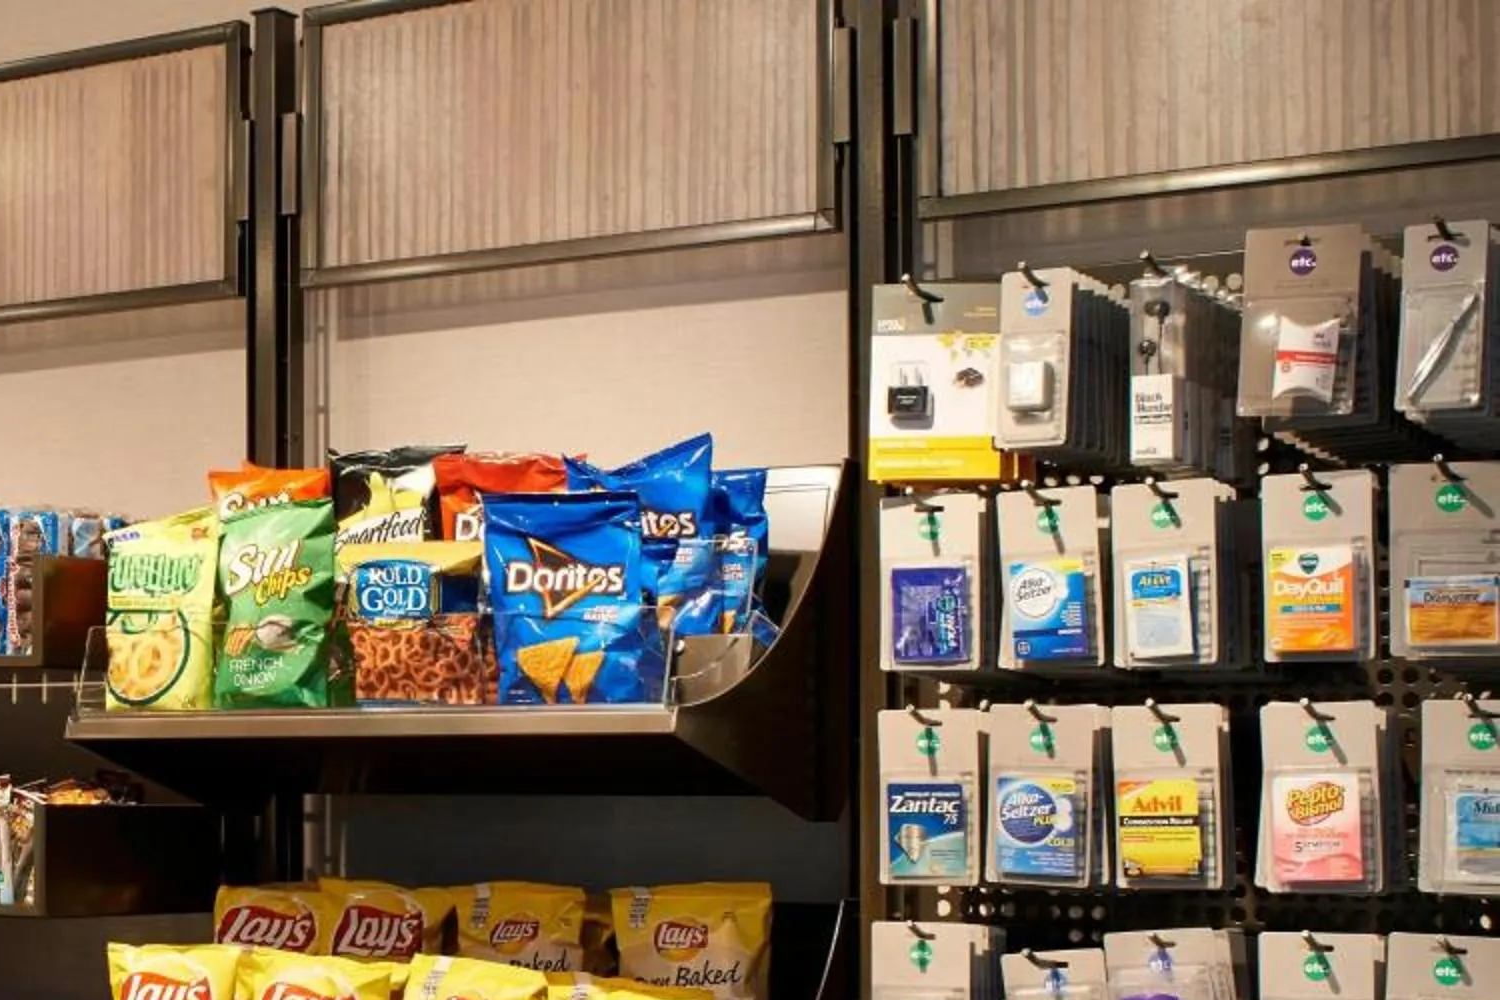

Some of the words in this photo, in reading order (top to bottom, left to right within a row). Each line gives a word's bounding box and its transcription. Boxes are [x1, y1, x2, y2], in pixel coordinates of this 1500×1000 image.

[640, 510, 696, 537] itos
[225, 538, 303, 596] Sun
[367, 564, 423, 587] ROLD
[506, 560, 624, 593] Doritos
[255, 566, 312, 607] Chips
[361, 585, 427, 612] GOLD
[1273, 577, 1345, 599] DayQuil
[229, 656, 284, 672] FRENCH
[232, 671, 278, 687] ONION
[889, 794, 961, 814] Zantac
[1000, 803, 1053, 821] Seltzer
[1131, 795, 1183, 813] Advil
[942, 814, 959, 826] 75
[222, 907, 313, 949] Lay's
[337, 907, 420, 957] Lay's
[493, 918, 539, 944] Lay's
[657, 921, 707, 949] Lay's
[674, 959, 742, 987] Baked
